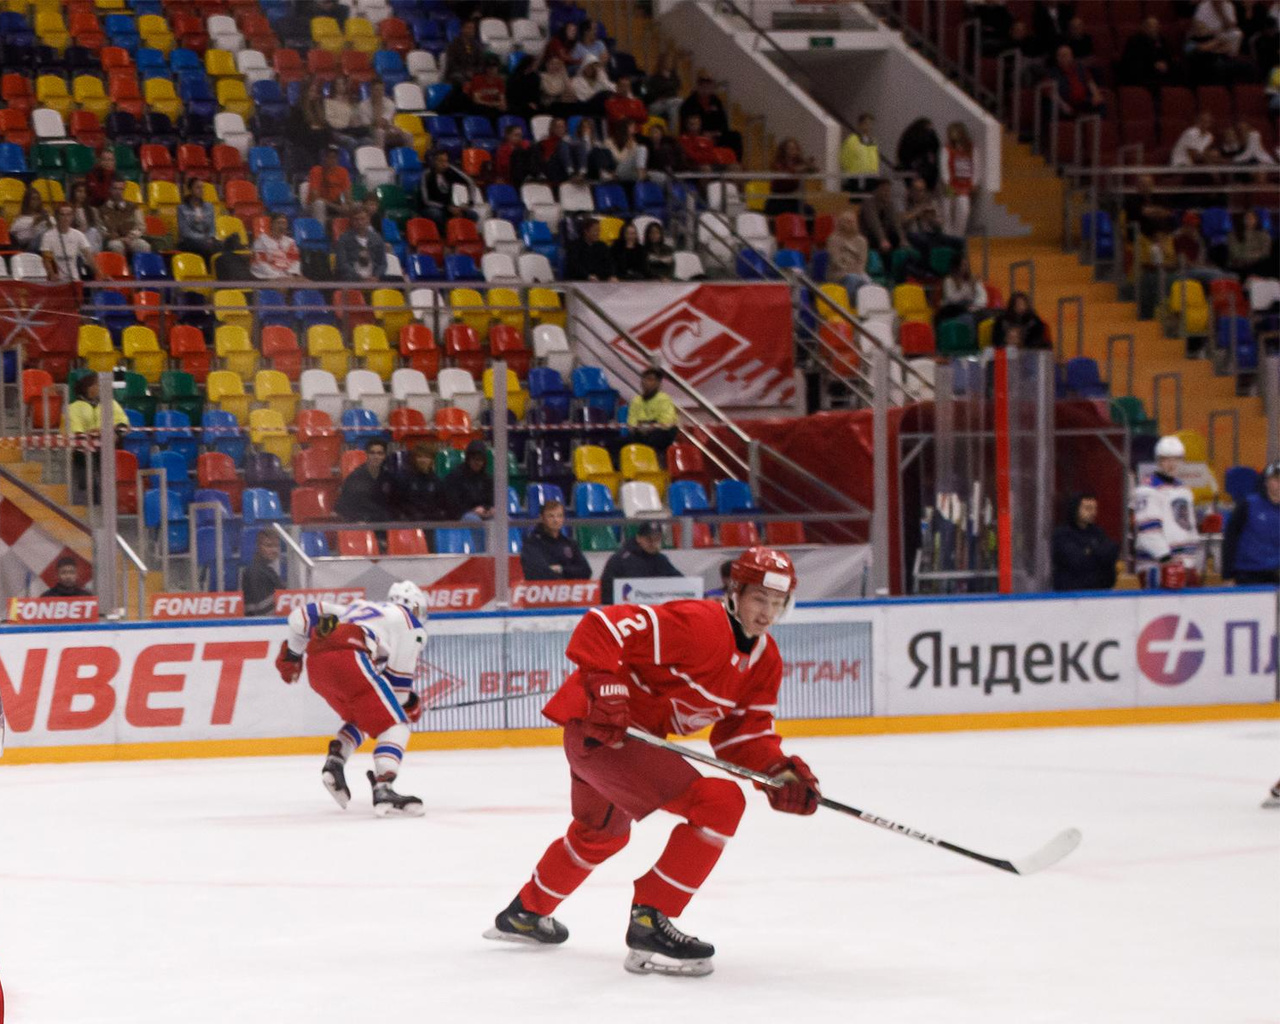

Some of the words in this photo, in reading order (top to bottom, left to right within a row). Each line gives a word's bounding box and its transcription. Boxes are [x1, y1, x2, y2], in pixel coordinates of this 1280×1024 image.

[425, 588, 479, 607] NBET
[513, 584, 598, 604] FONBET
[8, 601, 97, 620] FONBET
[153, 596, 242, 616] FONBET
[908, 631, 1120, 695] Яндекс
[479, 669, 549, 694] ВСЯ
